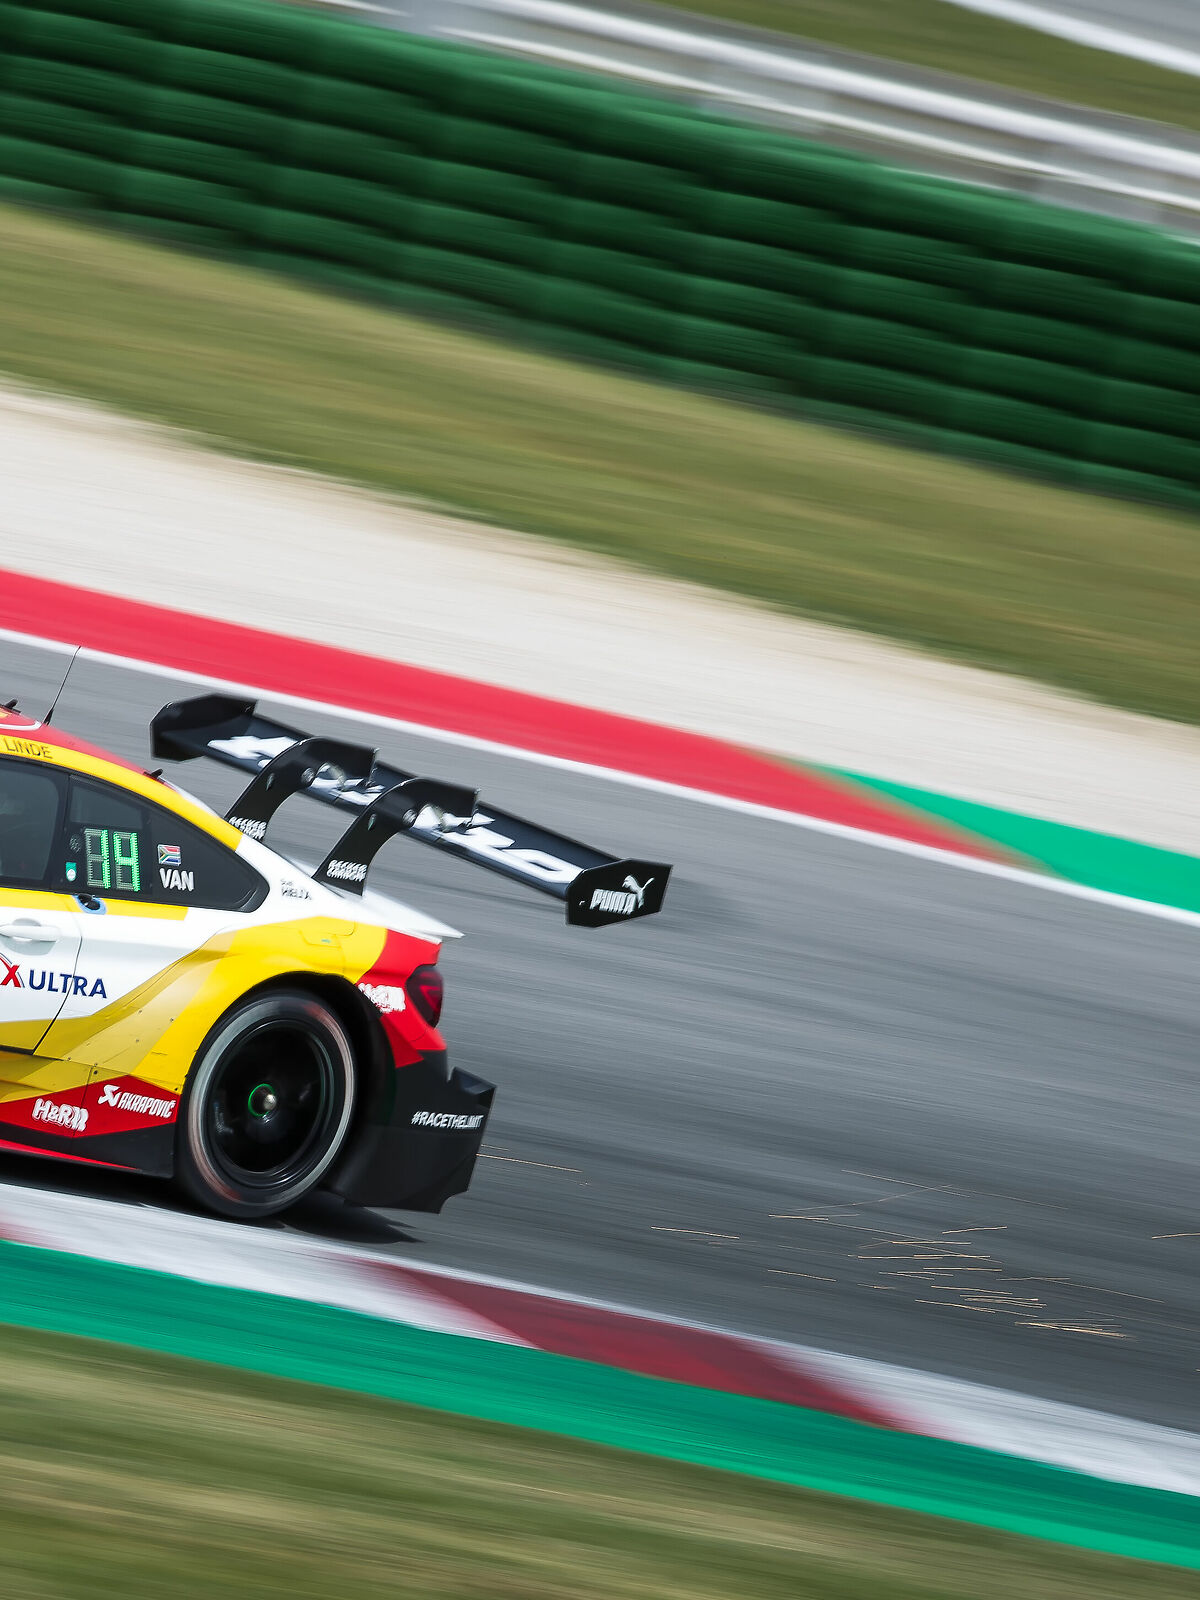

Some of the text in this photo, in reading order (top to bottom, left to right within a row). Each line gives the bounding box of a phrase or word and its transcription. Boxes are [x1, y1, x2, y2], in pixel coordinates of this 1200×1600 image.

[4, 739, 54, 760] LINDE
[159, 868, 194, 891] VAN
[29, 969, 107, 999] ULTRA
